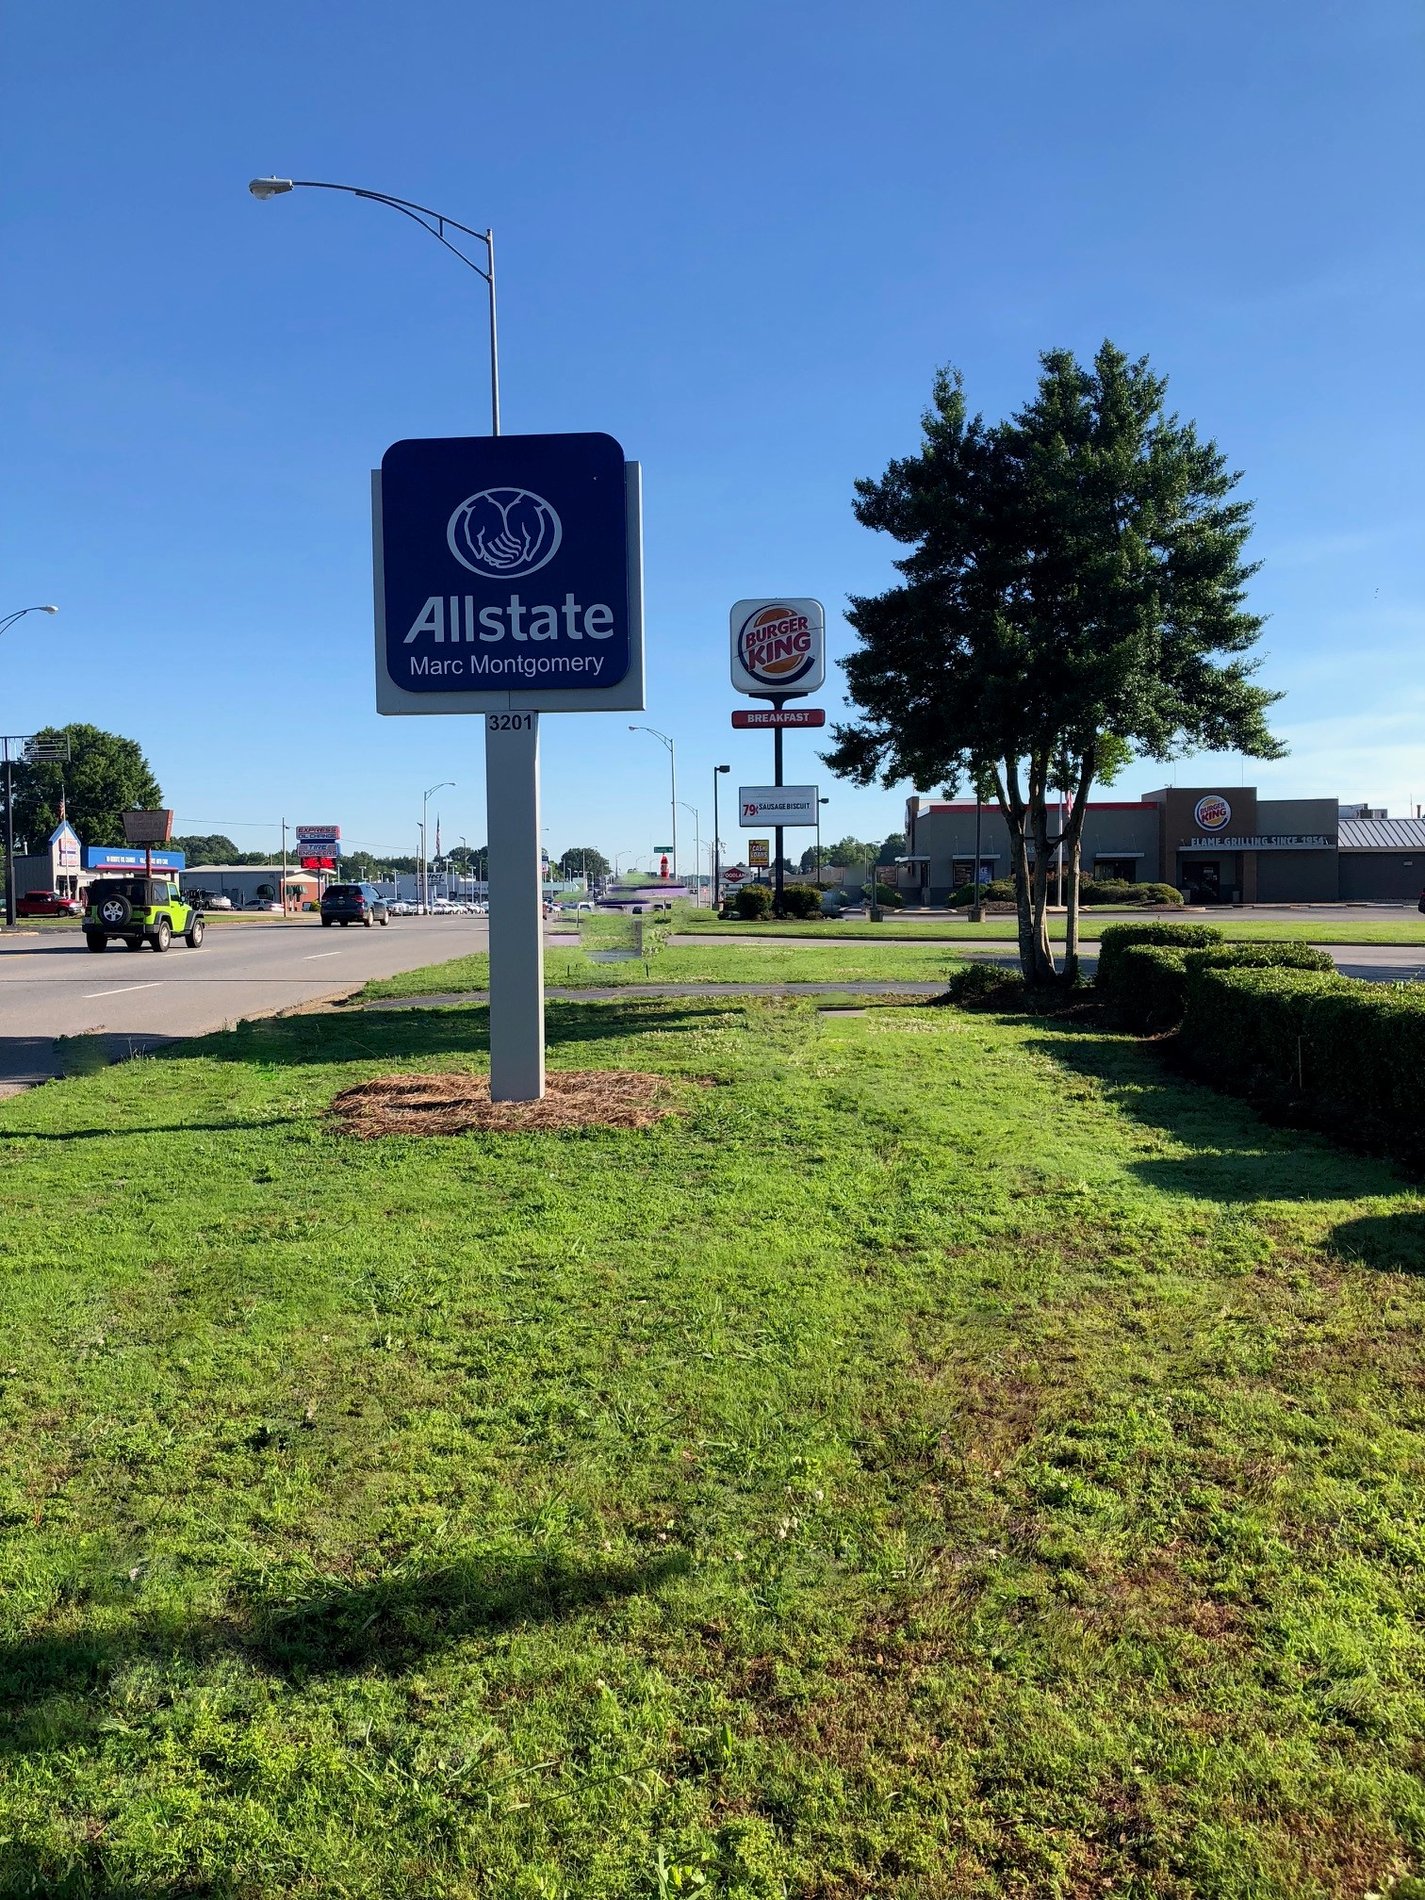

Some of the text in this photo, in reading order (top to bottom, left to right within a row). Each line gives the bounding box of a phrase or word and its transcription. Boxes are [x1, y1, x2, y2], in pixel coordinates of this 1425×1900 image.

[403, 593, 614, 643] Allstate
[746, 616, 808, 649] BURGER
[748, 632, 811, 671] KING
[410, 655, 604, 677] Marc Montgomery
[489, 715, 532, 730] 3201
[747, 713, 810, 722] BREAKFAST
[1200, 802, 1224, 814] BURGER
[1201, 808, 1227, 822] KING
[1191, 838, 1220, 846] FLAME
[1224, 838, 1268, 846] GRILLING
[1271, 837, 1297, 845] SINCE
